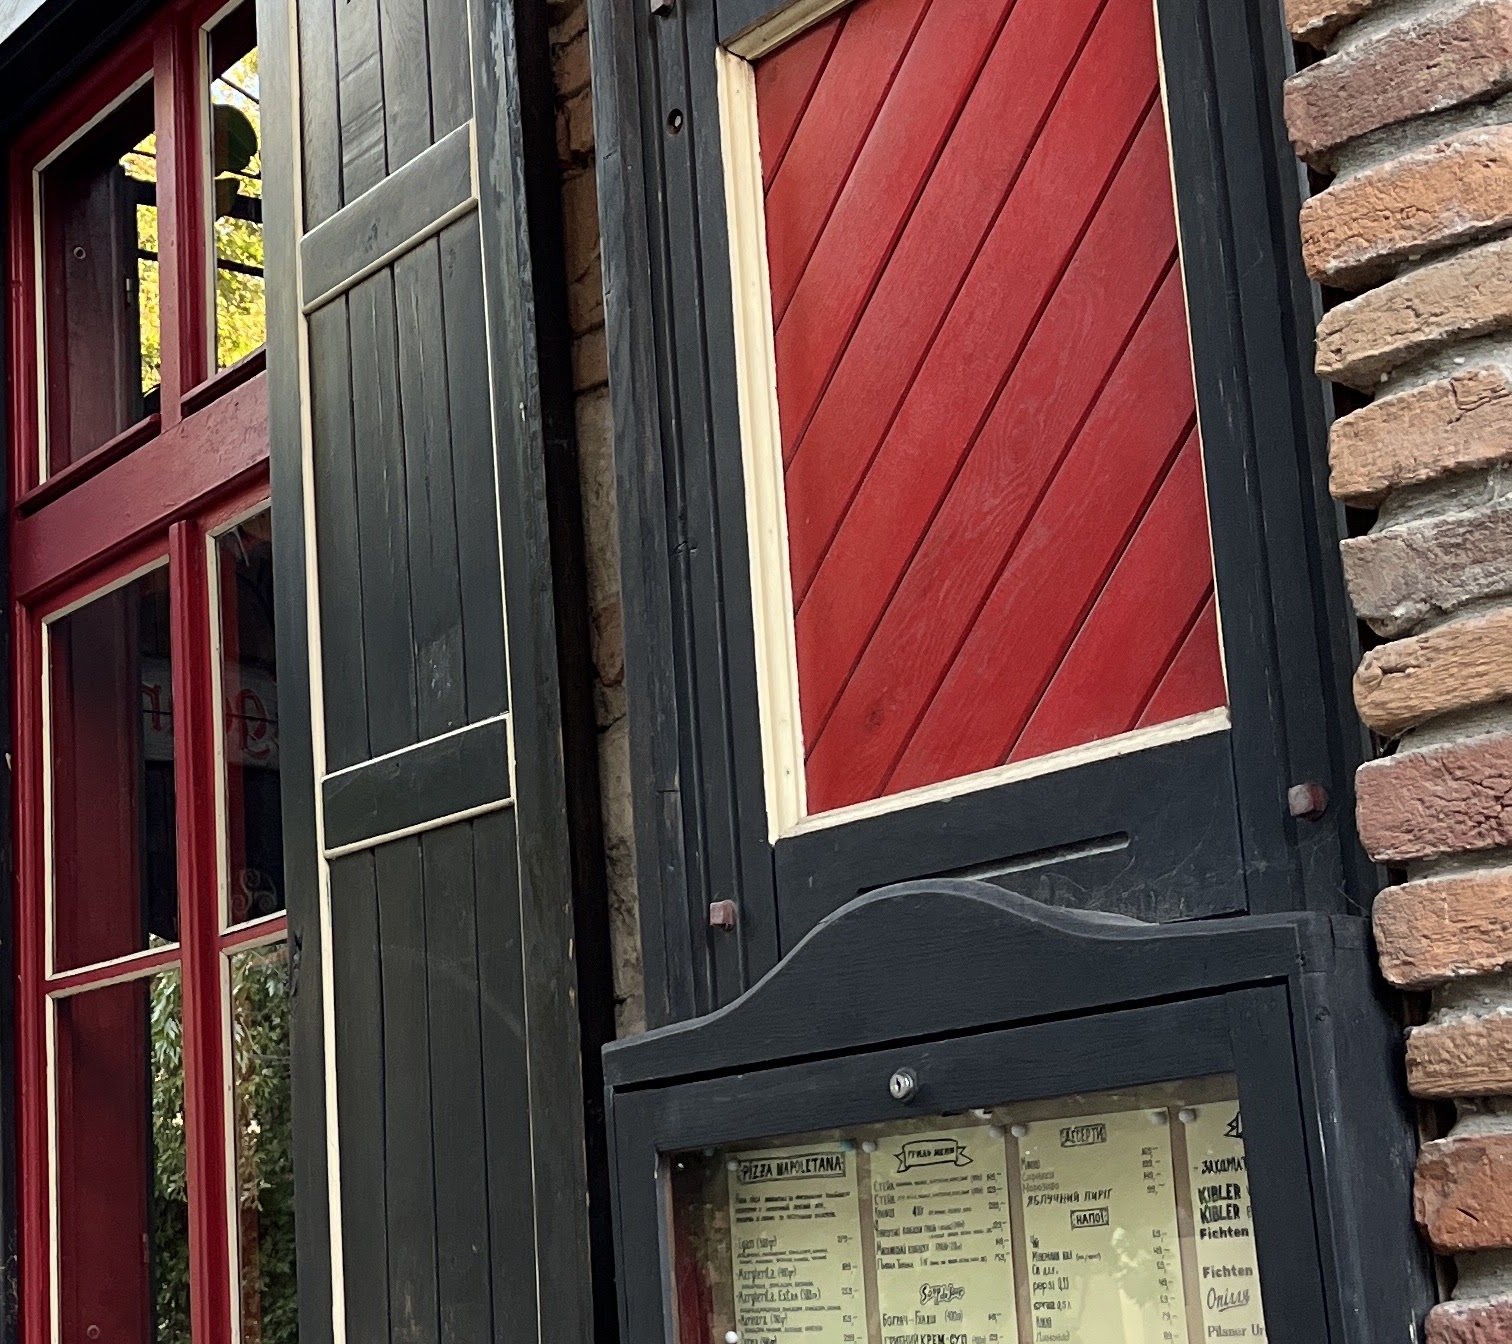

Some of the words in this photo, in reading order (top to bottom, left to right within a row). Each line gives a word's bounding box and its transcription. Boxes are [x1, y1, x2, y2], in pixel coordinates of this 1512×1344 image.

[742, 1163, 773, 1181] PIZZA
[776, 1156, 843, 1176] NAPOLETANA
[1026, 1191, 1080, 1207] ЯБЛУЧНИЙ
[1197, 1183, 1241, 1205] KIBLER
[1076, 1212, 1105, 1225] НАПОЇ
[1199, 1203, 1241, 1224] KIBLER
[1199, 1225, 1249, 1240] Fichten
[1202, 1264, 1253, 1278] Fichten
[1208, 1324, 1247, 1337] Pilsner
